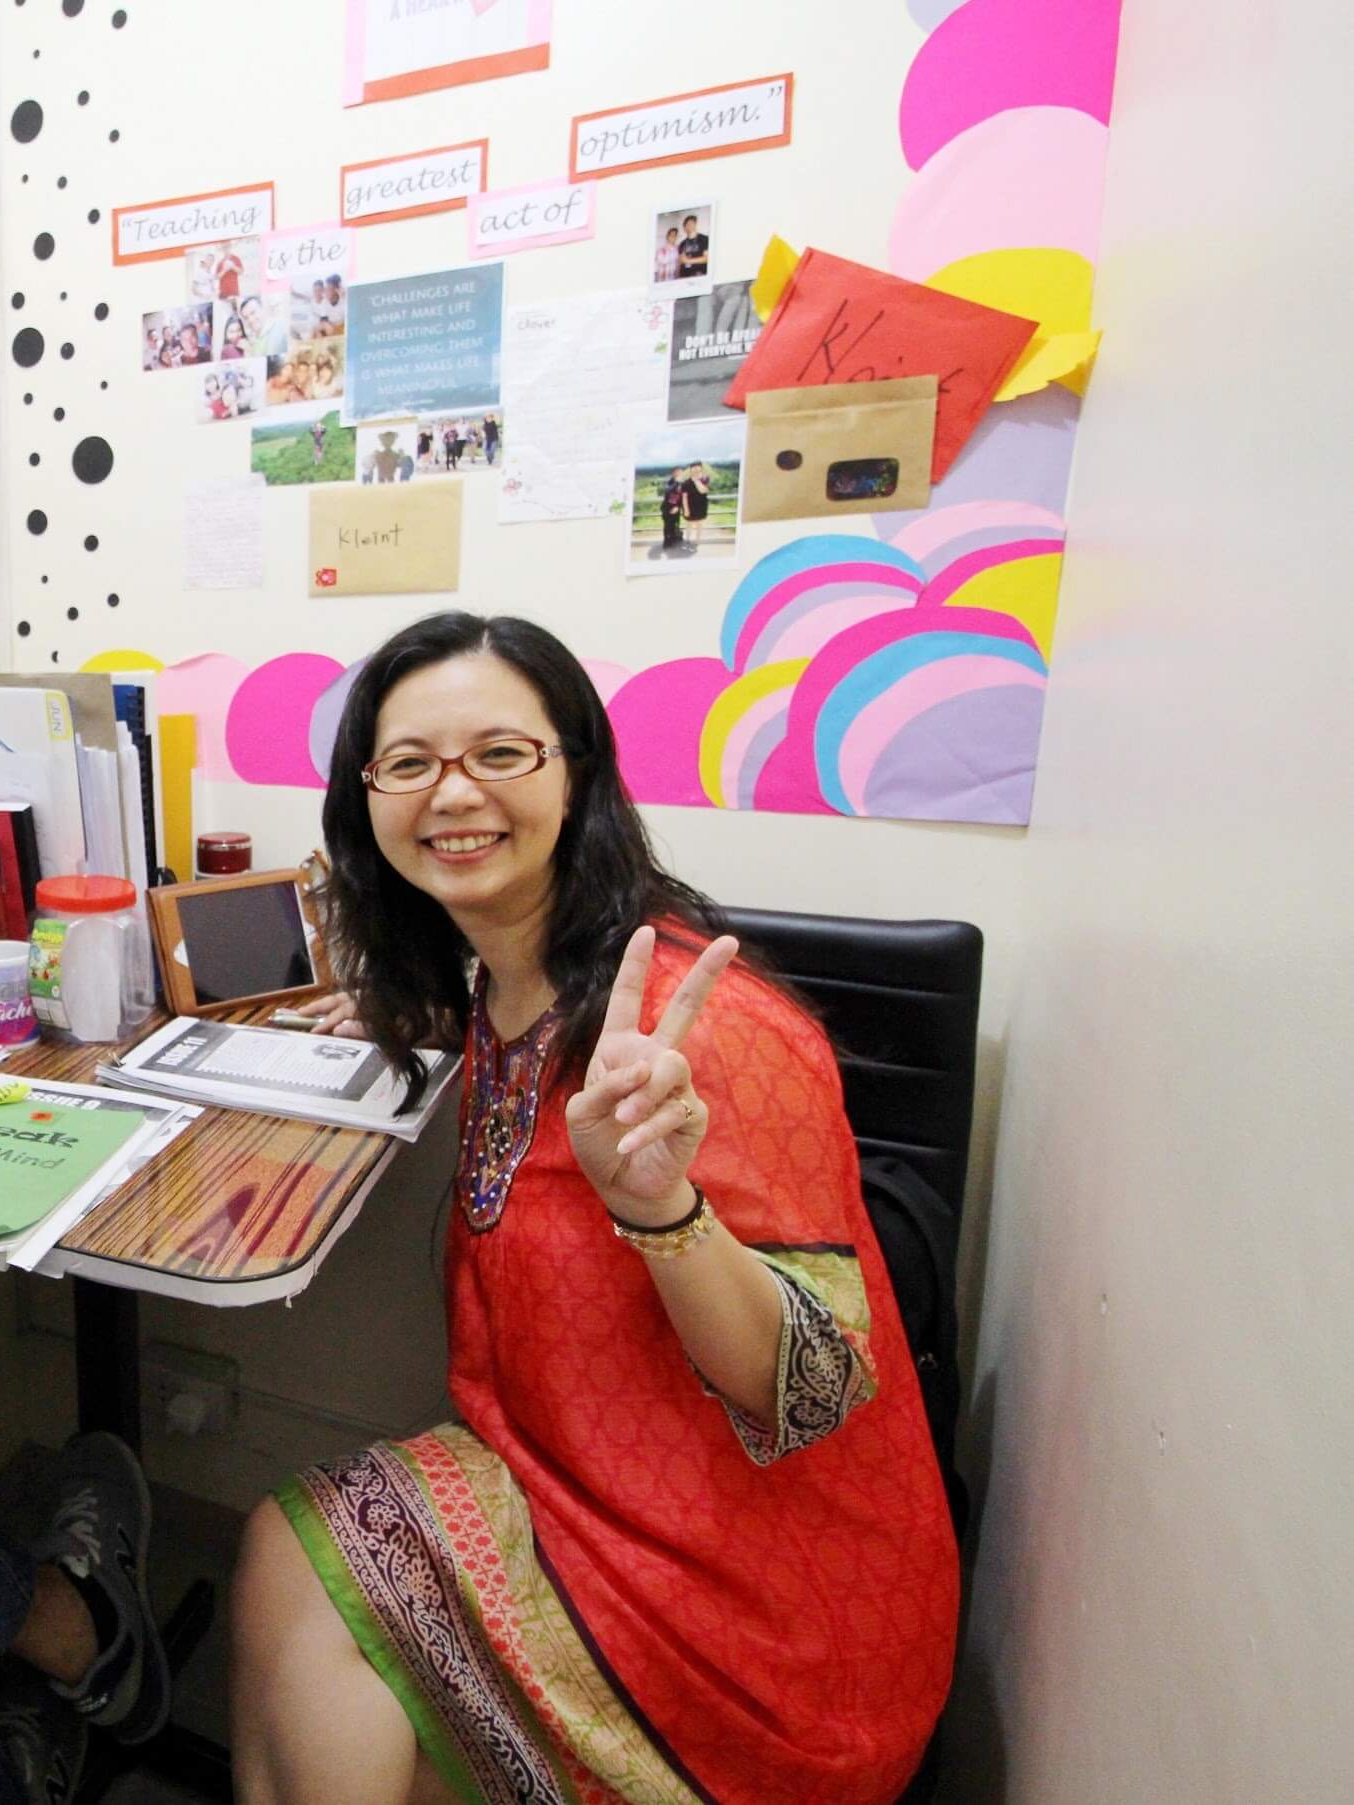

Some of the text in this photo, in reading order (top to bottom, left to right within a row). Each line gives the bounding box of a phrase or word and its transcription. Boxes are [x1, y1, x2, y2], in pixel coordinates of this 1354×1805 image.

[346, 159, 478, 215] greatest
[480, 188, 583, 233] act of
[267, 238, 347, 272] is the
[453, 281, 476, 295] ARE
[372, 301, 471, 324] WHAT MAKE LIFE
[367, 319, 477, 343] INTERESTING AND
[360, 343, 444, 363] OVERCOMING
[374, 363, 410, 378] WHAT
[414, 358, 453, 373] MAKES
[457, 355, 480, 368] LIFE
